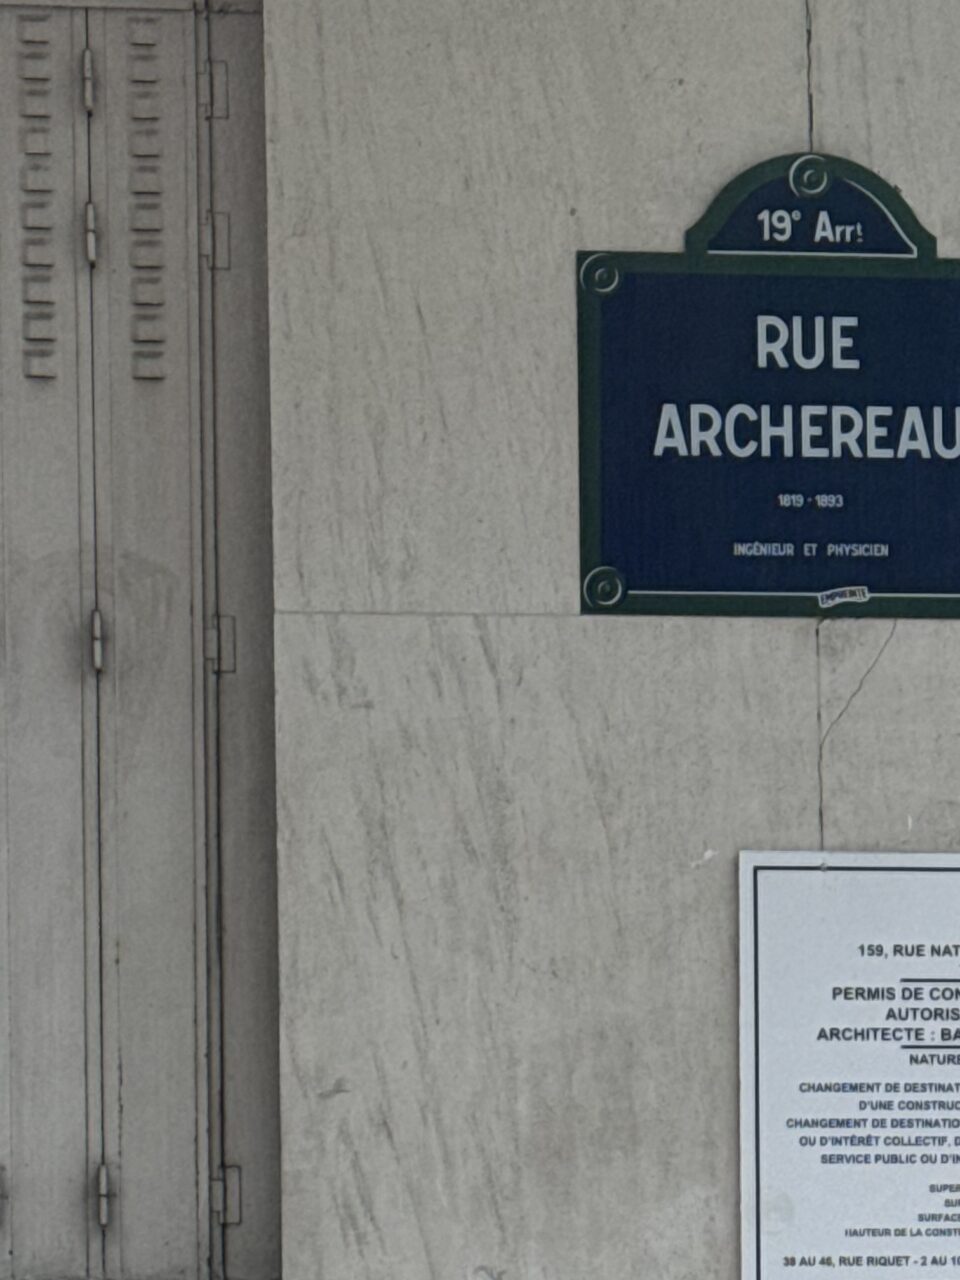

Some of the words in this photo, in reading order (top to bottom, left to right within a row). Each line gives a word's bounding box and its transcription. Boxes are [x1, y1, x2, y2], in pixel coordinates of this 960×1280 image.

[756, 315, 860, 369] RUE
[778, 494, 804, 508] 1819
[815, 494, 844, 508] 1893
[733, 541, 794, 557] INGÉNIEUR
[803, 543, 818, 557] ET
[827, 543, 889, 558] PHYSICIEN
[892, 944, 925, 957] RUE
[832, 987, 896, 1001] PERMIS
[900, 987, 924, 1001] DE
[817, 1027, 924, 1041] ARCHITECTE
[798, 1083, 880, 1093] CHANGEMENT
[884, 1083, 900, 1093] DE
[858, 1100, 894, 1111] D'UNE
[786, 1118, 867, 1128] CHANGEMENT
[870, 1118, 887, 1128] DE
[798, 1136, 816, 1146] OU
[819, 1134, 880, 1146] D'INTÉRÊT
[820, 1154, 871, 1164] SERVICE
[873, 1154, 917, 1164] PUBLIC
[919, 1154, 937, 1164] OU
